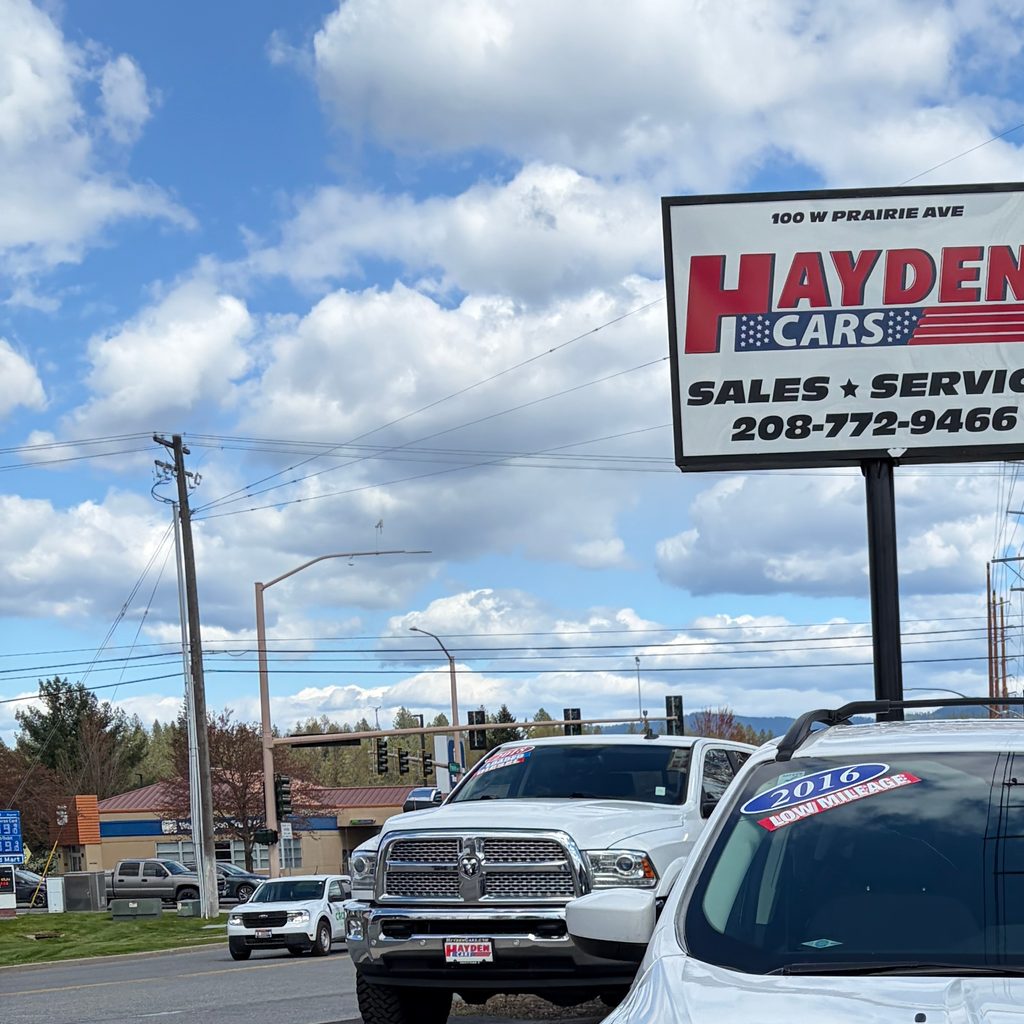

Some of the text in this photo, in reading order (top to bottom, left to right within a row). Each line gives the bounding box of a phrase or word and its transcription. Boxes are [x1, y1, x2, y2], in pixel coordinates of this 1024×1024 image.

[771, 205, 964, 224] 100 W PRAIRIE AVE
[772, 312, 885, 347] CARS
[687, 376, 830, 406] SALES
[731, 406, 1018, 442] 208-772-9466
[769, 774, 912, 827] LOW MILEAGE
[770, 766, 861, 808] 2016
[446, 945, 490, 957] HAYDEN
